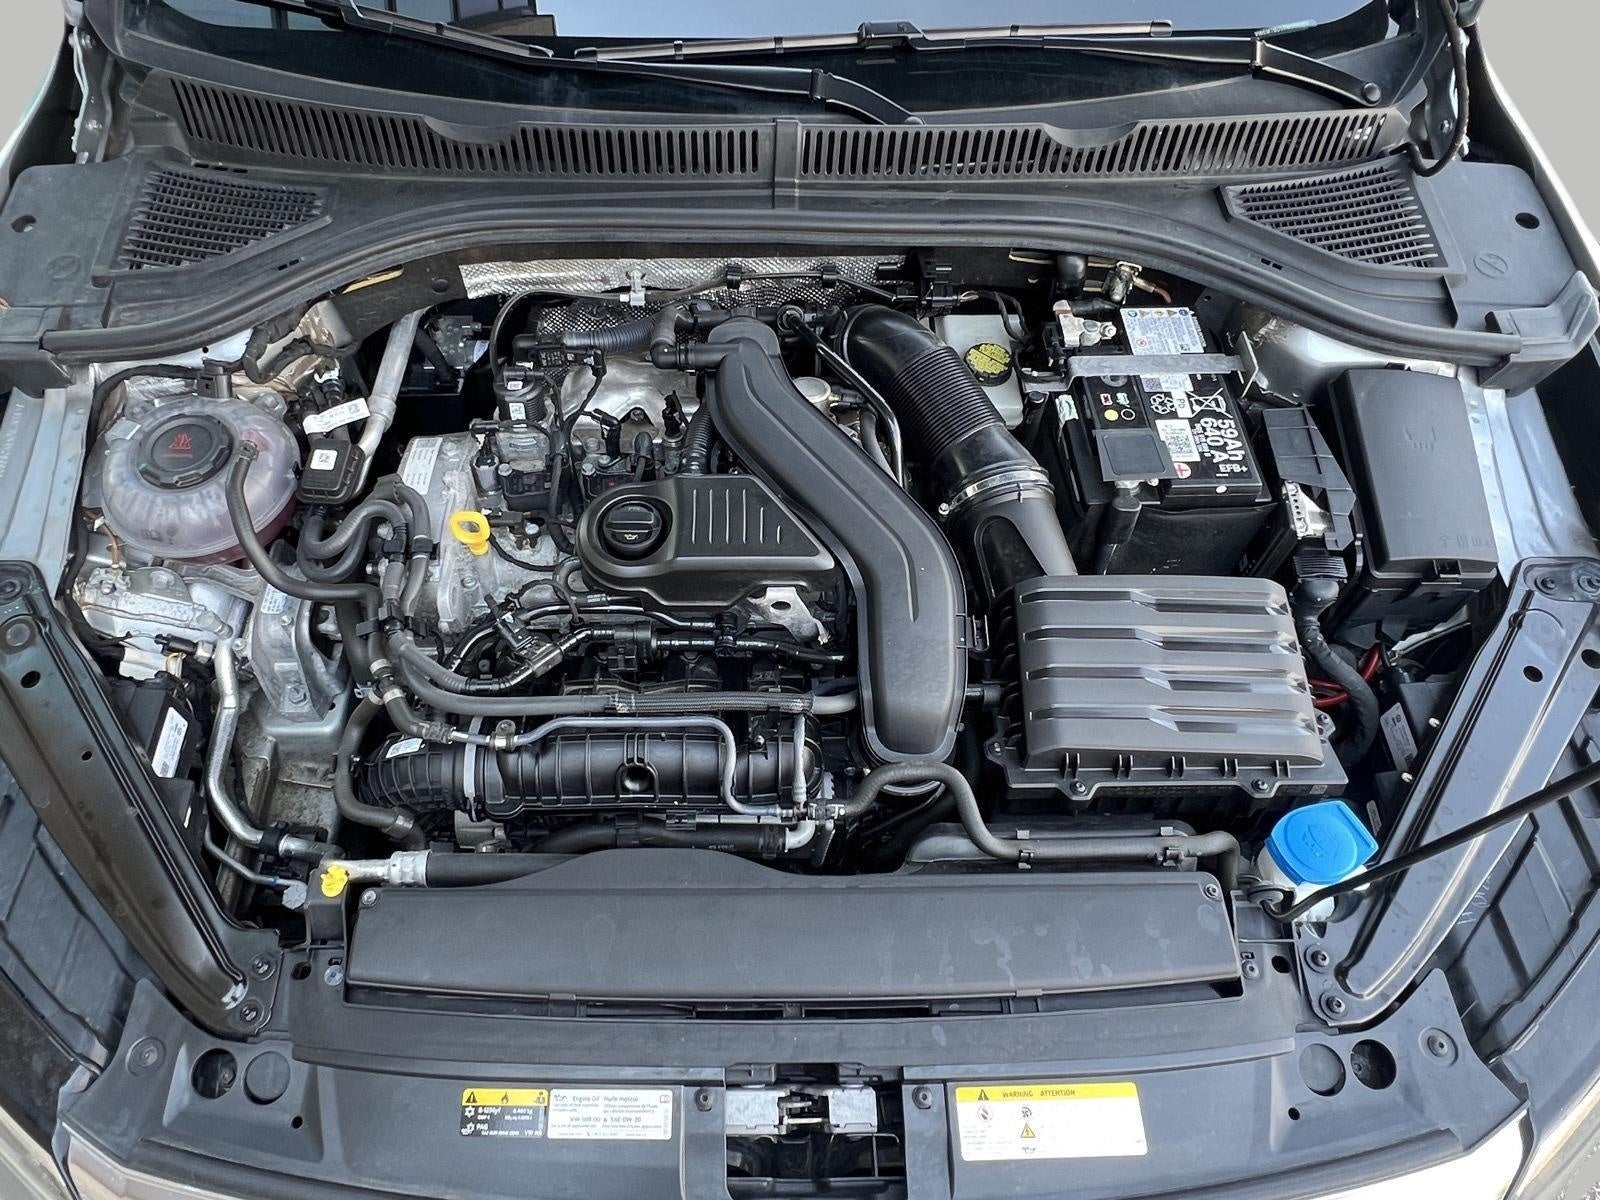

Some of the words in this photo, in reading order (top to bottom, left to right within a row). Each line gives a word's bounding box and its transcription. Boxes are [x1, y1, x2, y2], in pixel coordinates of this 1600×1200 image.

[1200, 417, 1225, 447] 640
[1217, 419, 1246, 461] 59Ah
[1210, 449, 1230, 464] A
[1002, 1090, 1034, 1098] WARNING
[1040, 1088, 1076, 1097] ATTENTION
[572, 1095, 590, 1104] Engine
[619, 1095, 639, 1104] moteur
